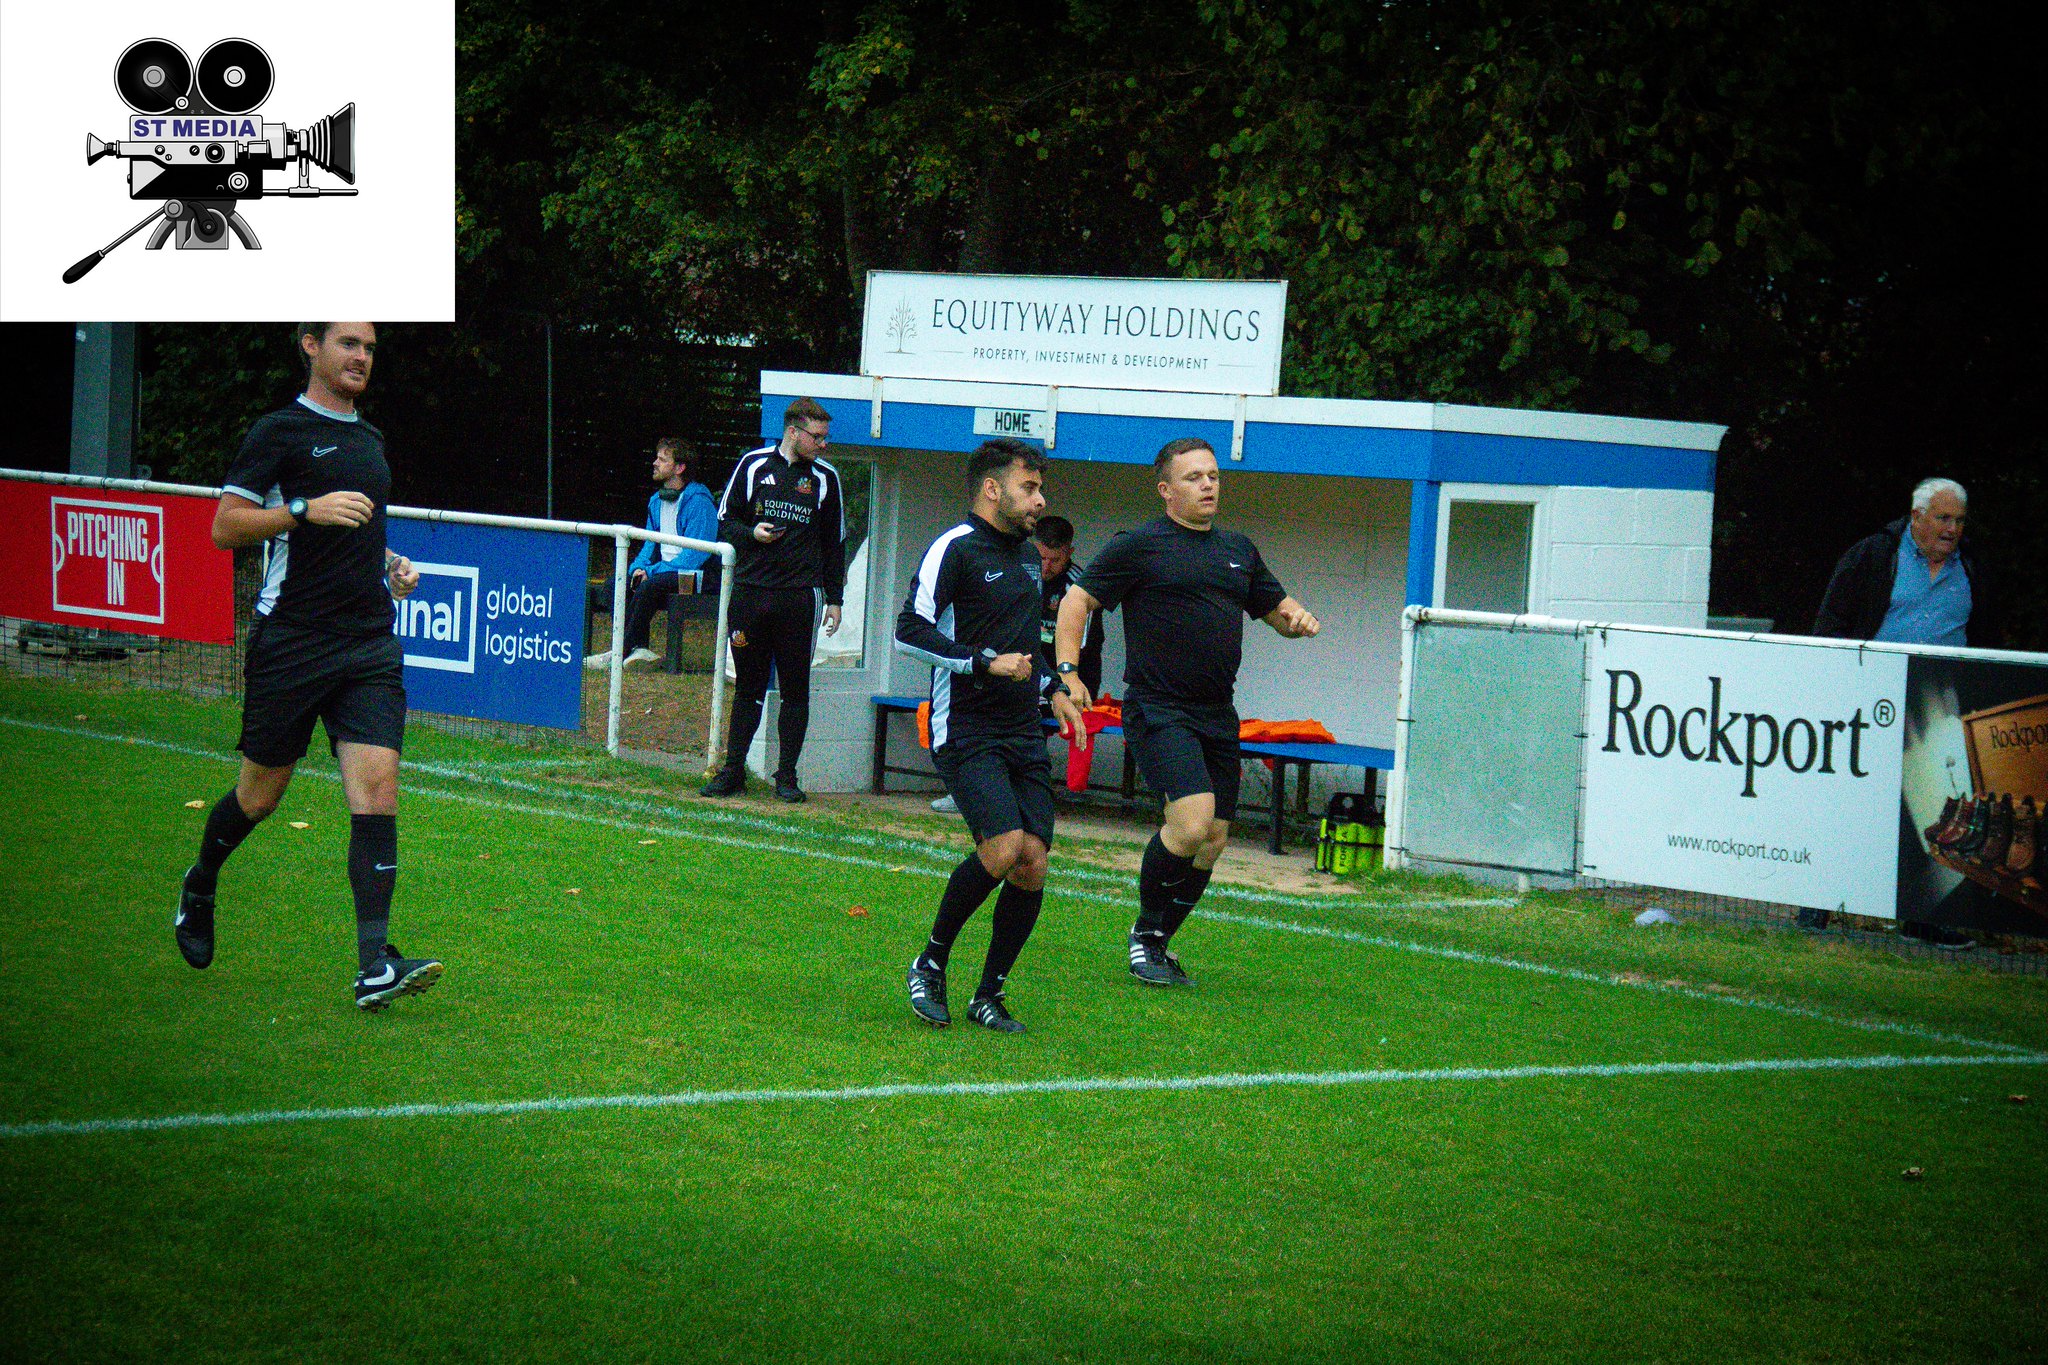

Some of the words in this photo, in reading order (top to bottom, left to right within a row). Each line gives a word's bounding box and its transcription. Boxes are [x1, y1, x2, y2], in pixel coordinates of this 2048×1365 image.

[932, 298, 1094, 335] EQUITYWAY
[1103, 305, 1261, 343] HOLDINGS
[973, 347, 1030, 363] PROPERTY,
[1035, 350, 1107, 365] INVESTMENT
[1111, 353, 1119, 365] &
[1124, 354, 1209, 370] DEVELOPMENT
[994, 411, 1031, 433] HOME
[764, 499, 813, 516] EQUITYWAY
[764, 508, 811, 524] HOLDINGS
[67, 511, 148, 563] PITCHING
[107, 561, 125, 606] IN
[393, 590, 462, 643] inal
[486, 583, 553, 620] global
[485, 625, 572, 665] logistics
[1989, 721, 2048, 753] Rockpo
[1667, 833, 1812, 866] www.rockport.co.uk
